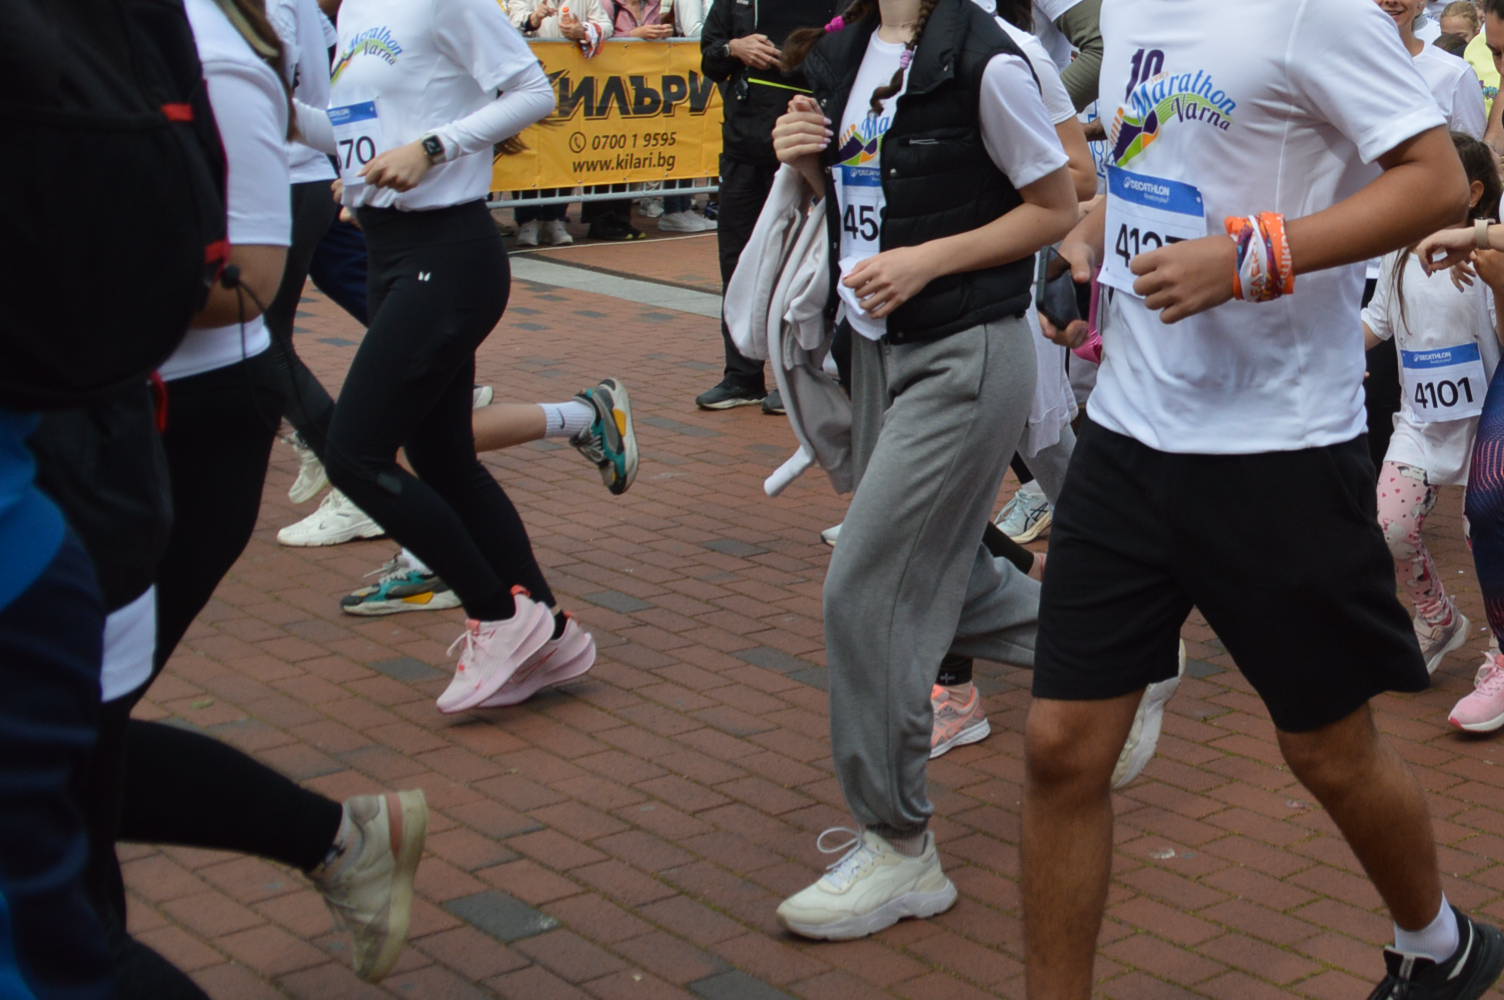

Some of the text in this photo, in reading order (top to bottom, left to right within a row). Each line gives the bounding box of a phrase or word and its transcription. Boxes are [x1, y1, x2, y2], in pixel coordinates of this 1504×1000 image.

[1131, 69, 1237, 122] Marathon
[1171, 97, 1231, 131] Varna
[592, 131, 677, 150] 0700 1 9595
[572, 152, 676, 173] www.kilari.bg
[1415, 376, 1474, 409] 4101
